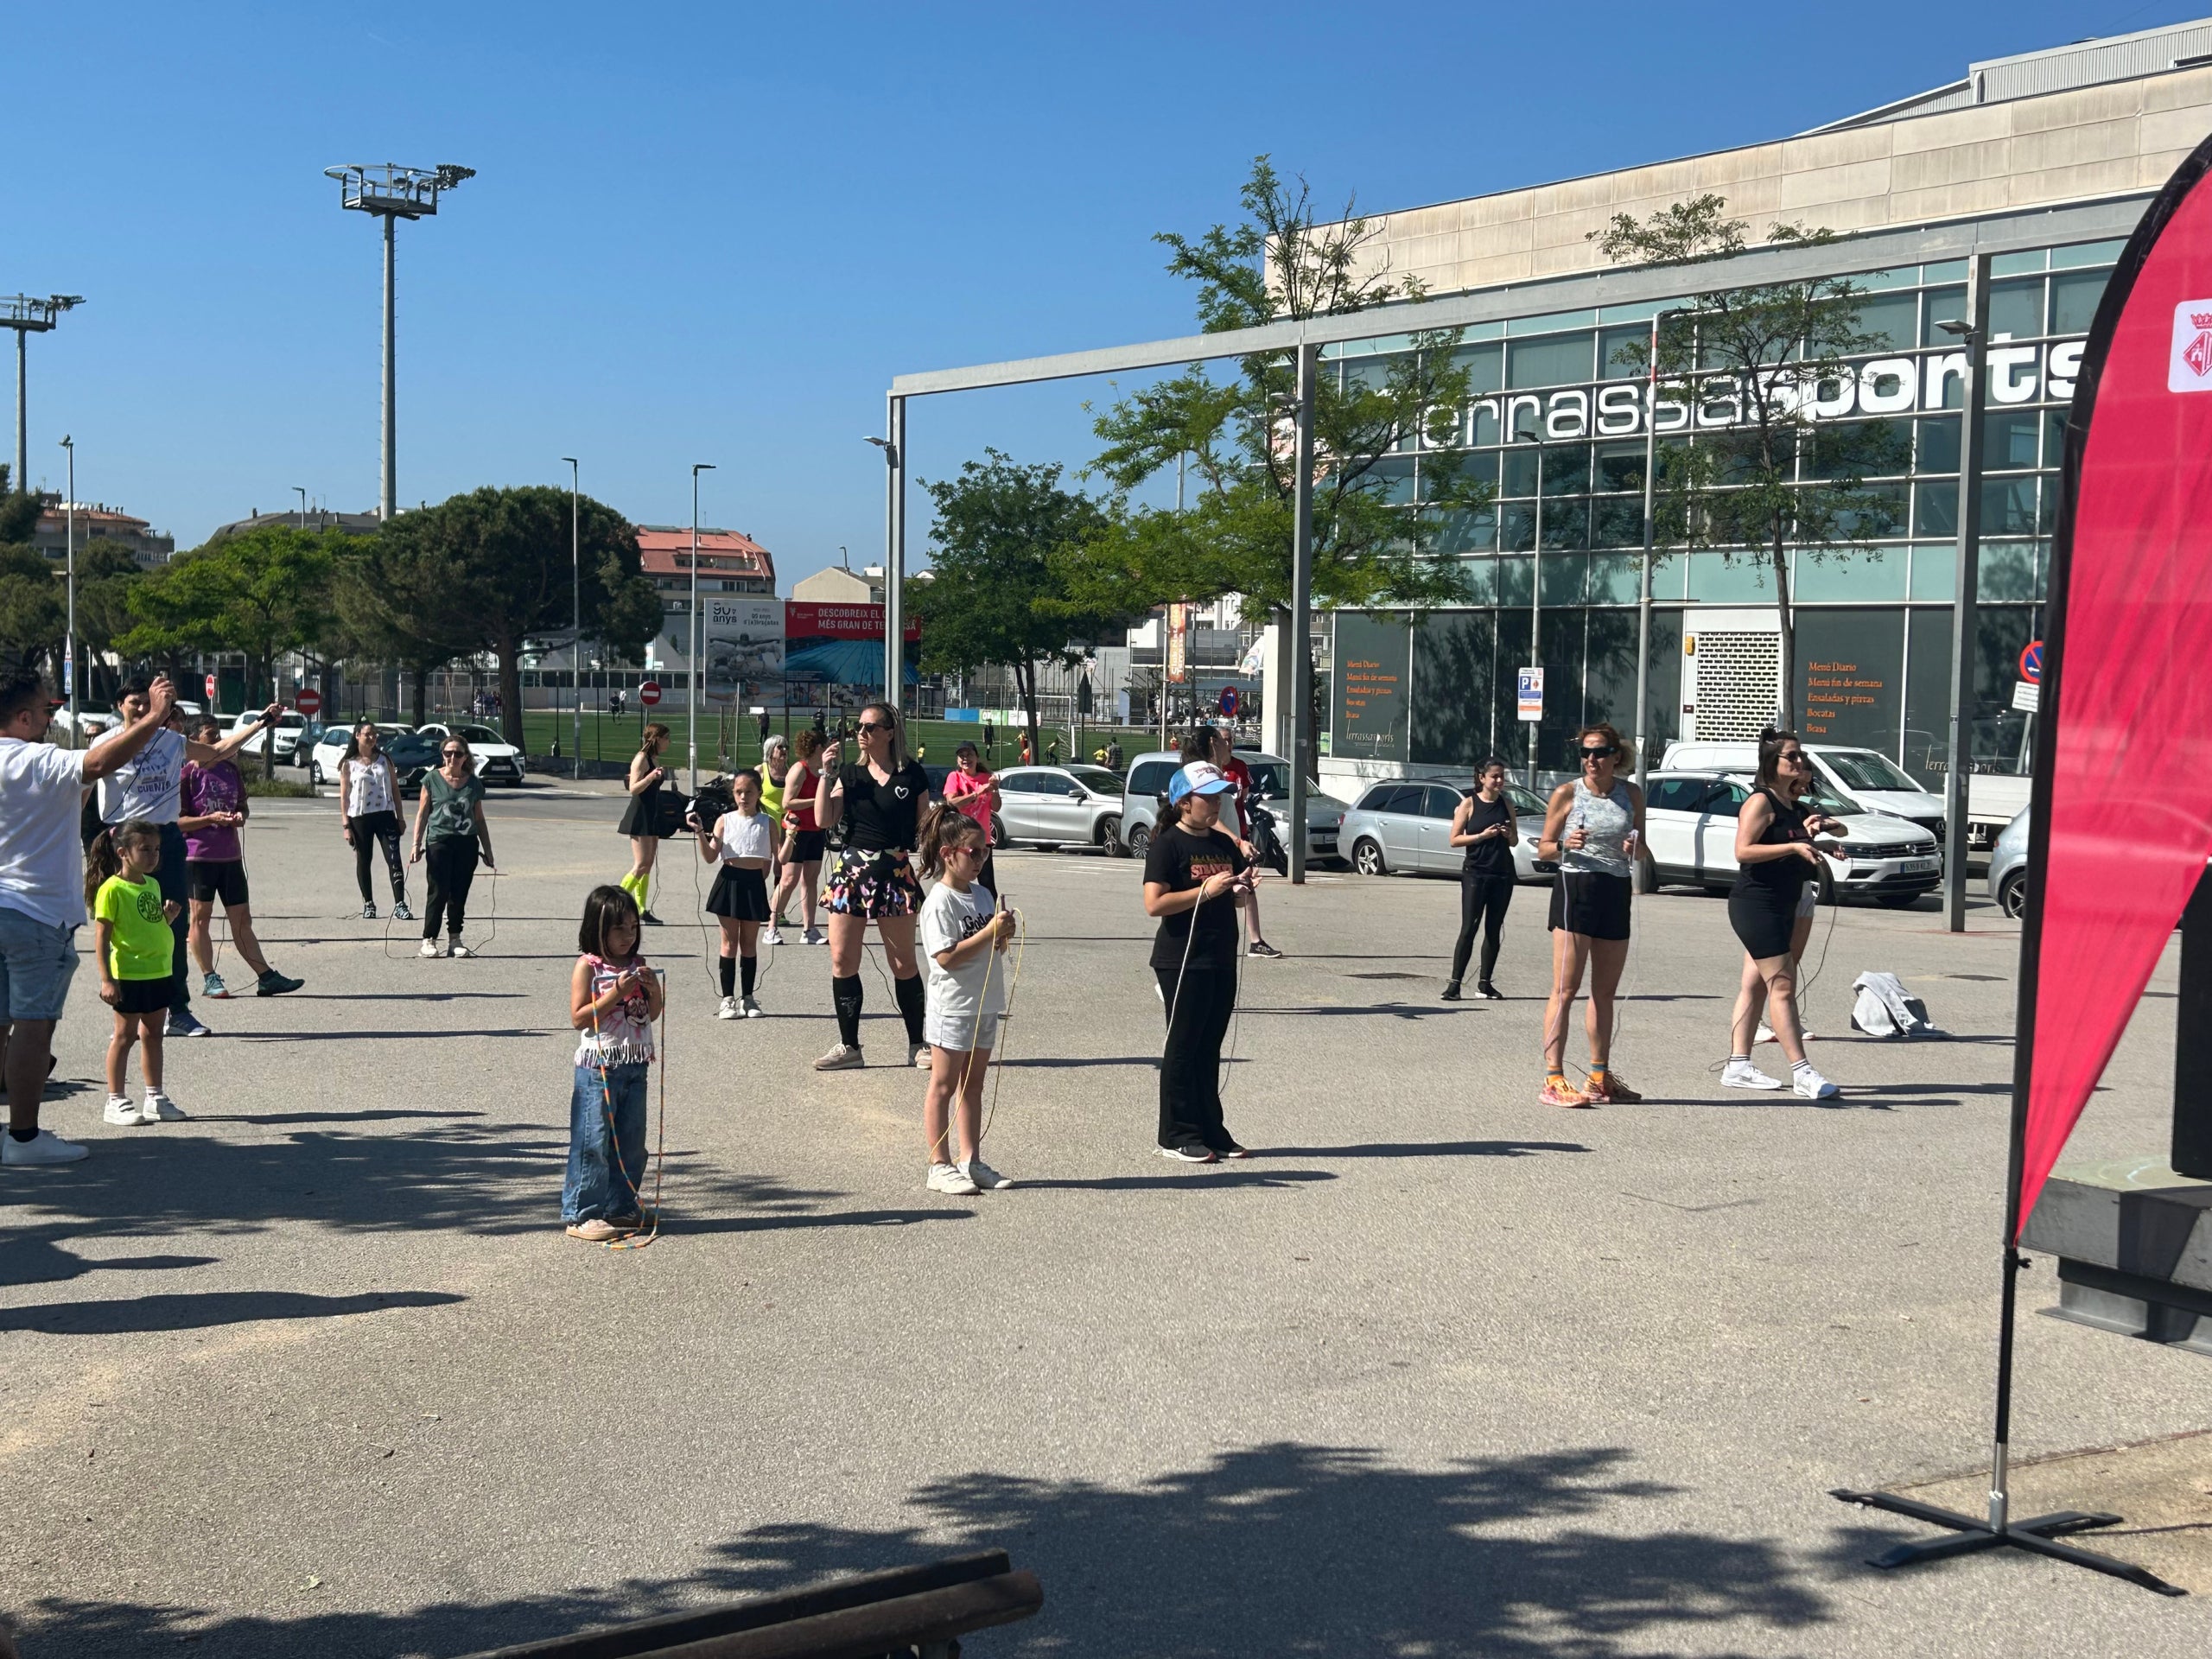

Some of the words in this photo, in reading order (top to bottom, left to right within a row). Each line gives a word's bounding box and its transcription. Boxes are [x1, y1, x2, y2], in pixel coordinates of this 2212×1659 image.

[818, 608, 868, 619] DESCOBREIX
[870, 610, 880, 619] EL
[818, 620, 836, 629] MÉS
[837, 620, 860, 630] GRAN
[862, 620, 873, 630] DE
[1832, 662, 1857, 671] Diario
[1522, 677, 1529, 690] P
[1843, 677, 1853, 688] de
[1807, 709, 1835, 718] Bocatas
